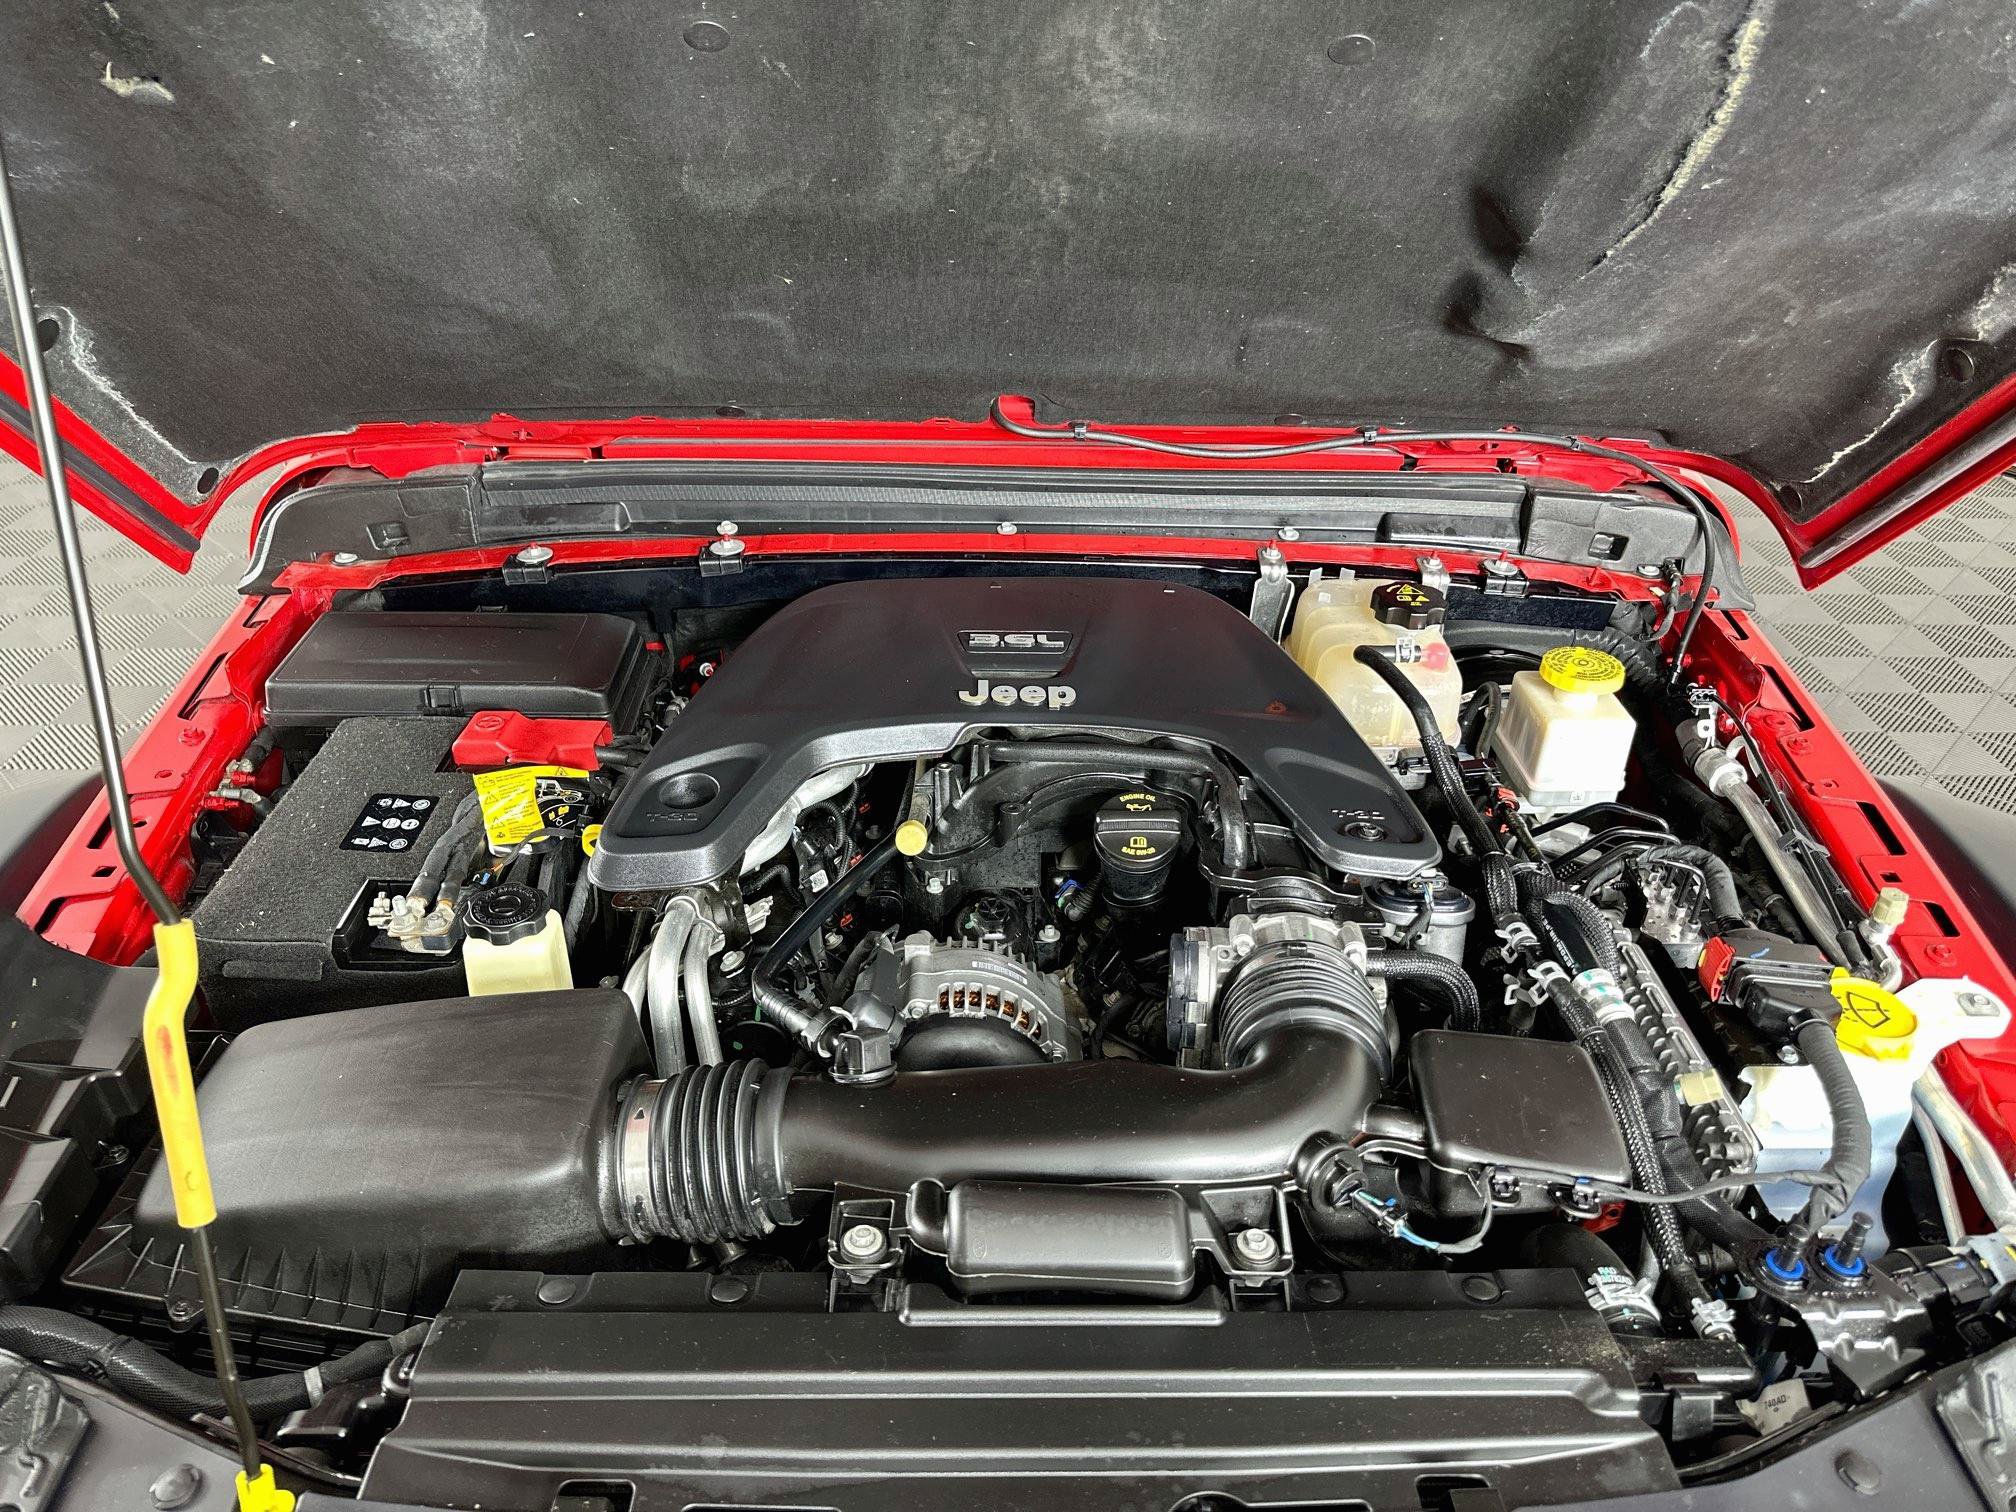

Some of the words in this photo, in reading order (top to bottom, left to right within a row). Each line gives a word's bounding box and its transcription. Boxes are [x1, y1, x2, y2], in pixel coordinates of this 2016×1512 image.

[968, 632, 1065, 648] 3.6L
[957, 679, 1078, 711] Jeep
[1119, 793, 1145, 803] ENGINE
[1145, 794, 1156, 803] OIL
[1121, 846, 1136, 856] SAE
